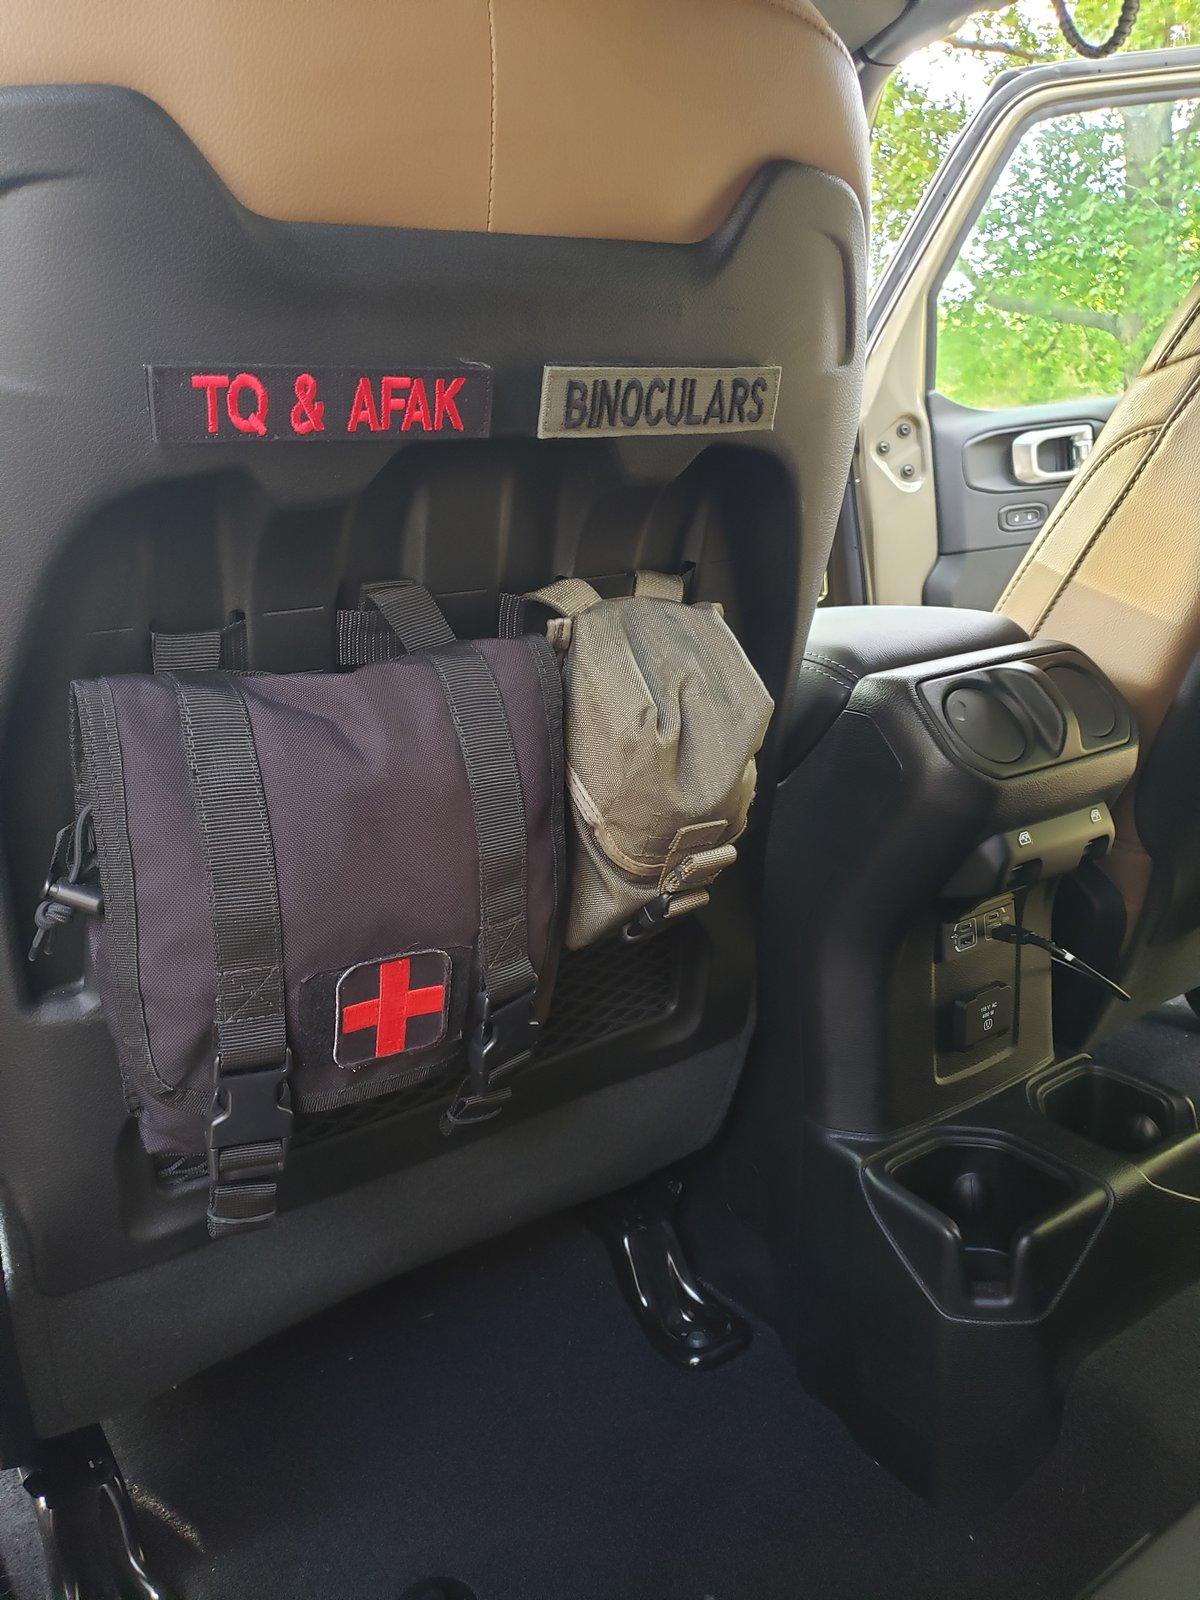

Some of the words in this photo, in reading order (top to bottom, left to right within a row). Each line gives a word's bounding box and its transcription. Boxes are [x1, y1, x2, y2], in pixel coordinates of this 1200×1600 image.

[191, 373, 268, 436] TQ
[290, 373, 325, 435] &
[347, 376, 466, 432] AFAK
[563, 377, 768, 429] BINOCULARS
